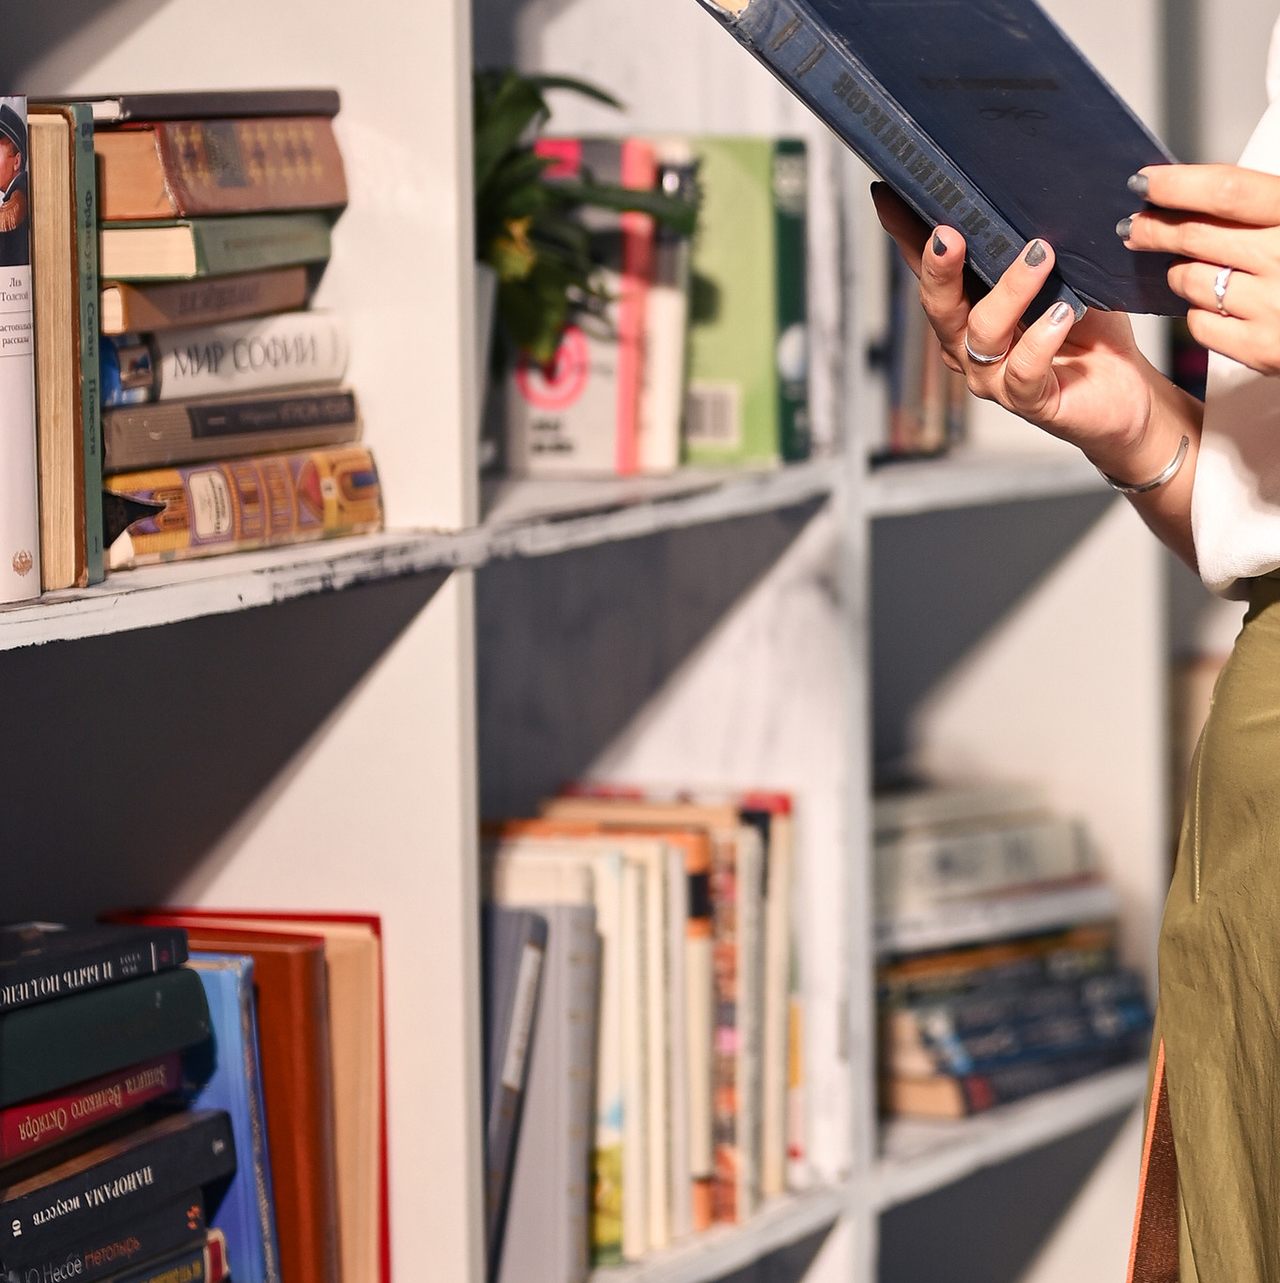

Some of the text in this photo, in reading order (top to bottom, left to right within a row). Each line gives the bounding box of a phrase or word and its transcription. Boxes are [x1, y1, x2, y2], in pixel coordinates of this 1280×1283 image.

[83, 190, 97, 456] Франсуаза Саган Повести
[174, 333, 317, 378] МИР СОФИИ
[63, 967, 100, 990] БЫТЬ
[18, 1064, 167, 1143] Защита Великого Октября
[33, 1165, 155, 1226] ПАНОРАМА искусств
[84, 1235, 142, 1270] Нетопырь
